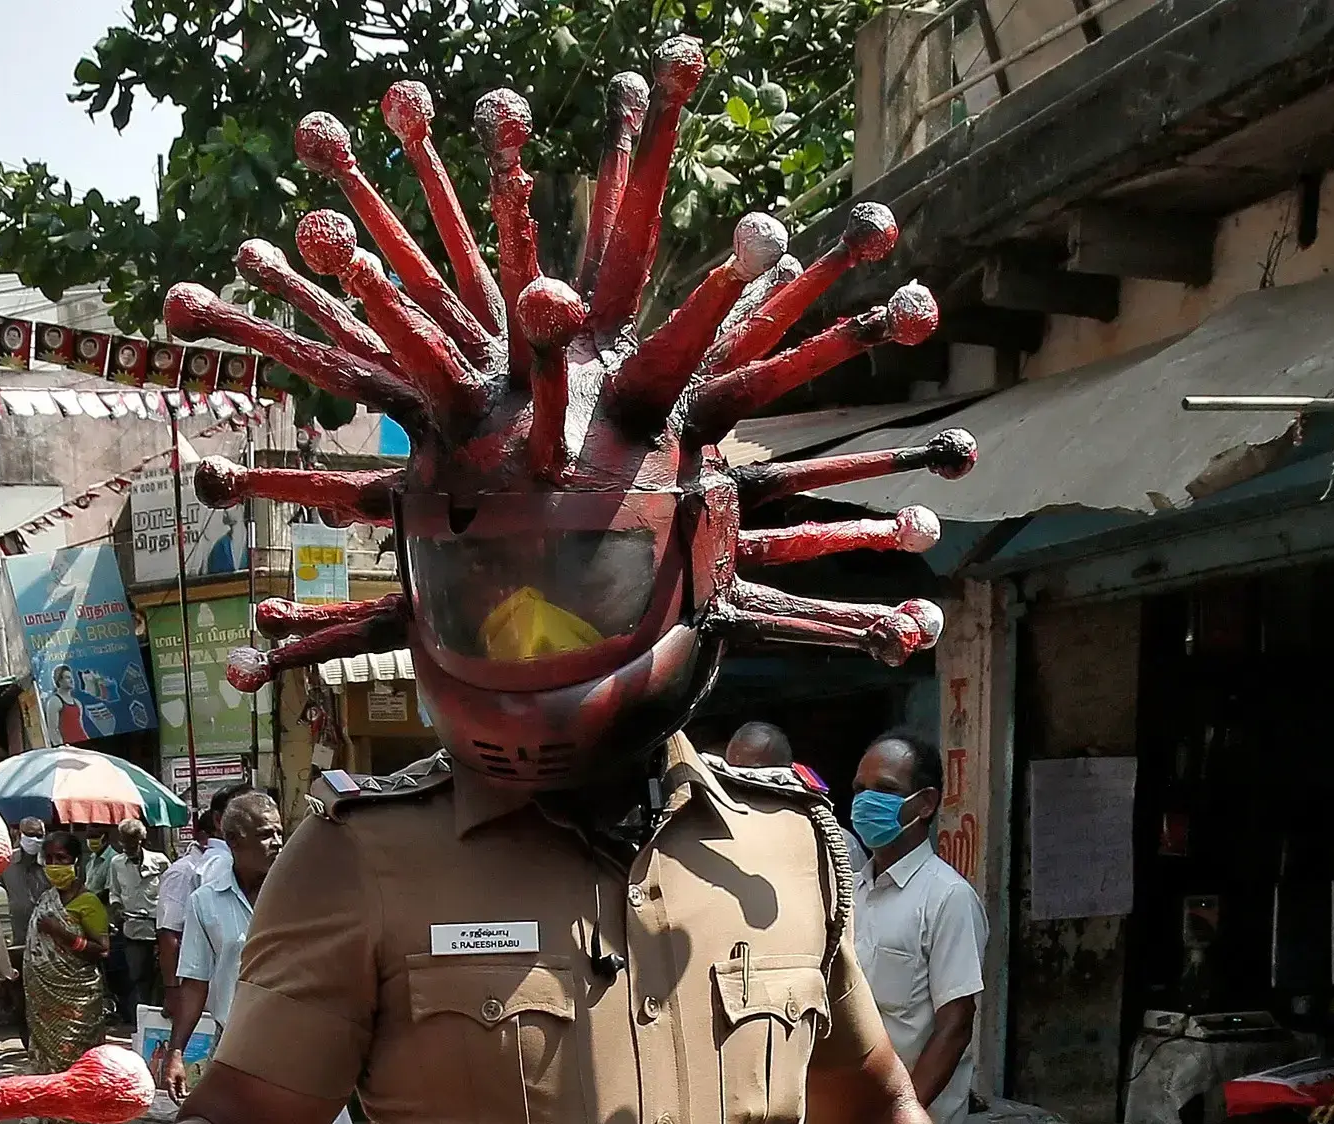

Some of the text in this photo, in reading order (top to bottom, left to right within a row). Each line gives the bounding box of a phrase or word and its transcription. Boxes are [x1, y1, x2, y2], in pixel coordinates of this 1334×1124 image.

[30, 622, 130, 649] MATTA BROS
[208, 624, 251, 644] பிரதர்
[158, 649, 214, 667] MATA
[460, 940, 497, 949] RAJEESH
[497, 940, 520, 948] BABU
